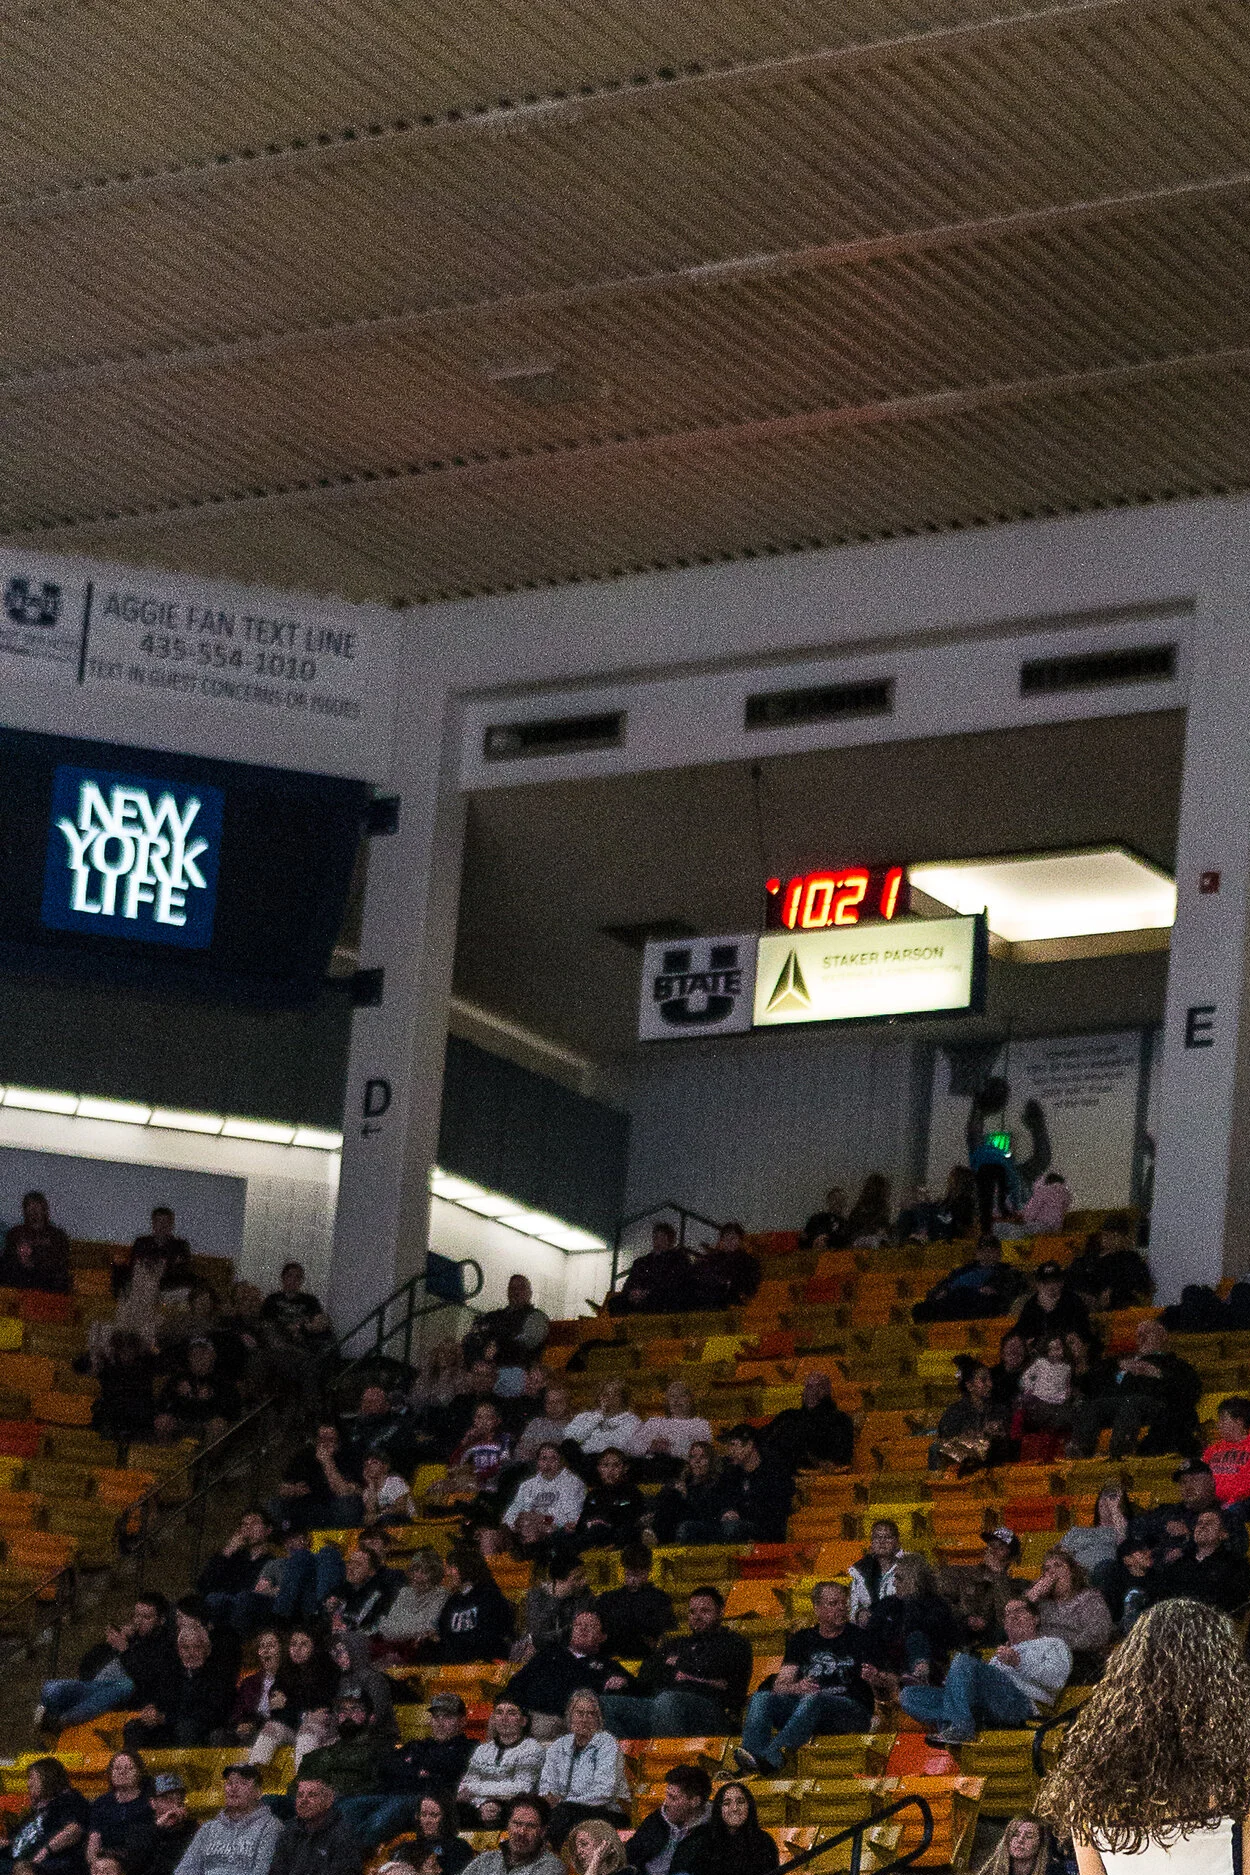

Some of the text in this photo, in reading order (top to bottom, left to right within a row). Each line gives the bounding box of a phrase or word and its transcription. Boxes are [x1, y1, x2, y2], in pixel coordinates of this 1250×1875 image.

[103, 591, 357, 661] AGGIE FAN TEXT LINE
[77, 780, 201, 840] NEW
[55, 816, 208, 889] YORK
[71, 866, 187, 927] LIFE
[822, 946, 945, 971] STAKER PARSON
[652, 969, 743, 1002] STATE
[1185, 1004, 1217, 1050] E
[362, 1078, 394, 1119] D
